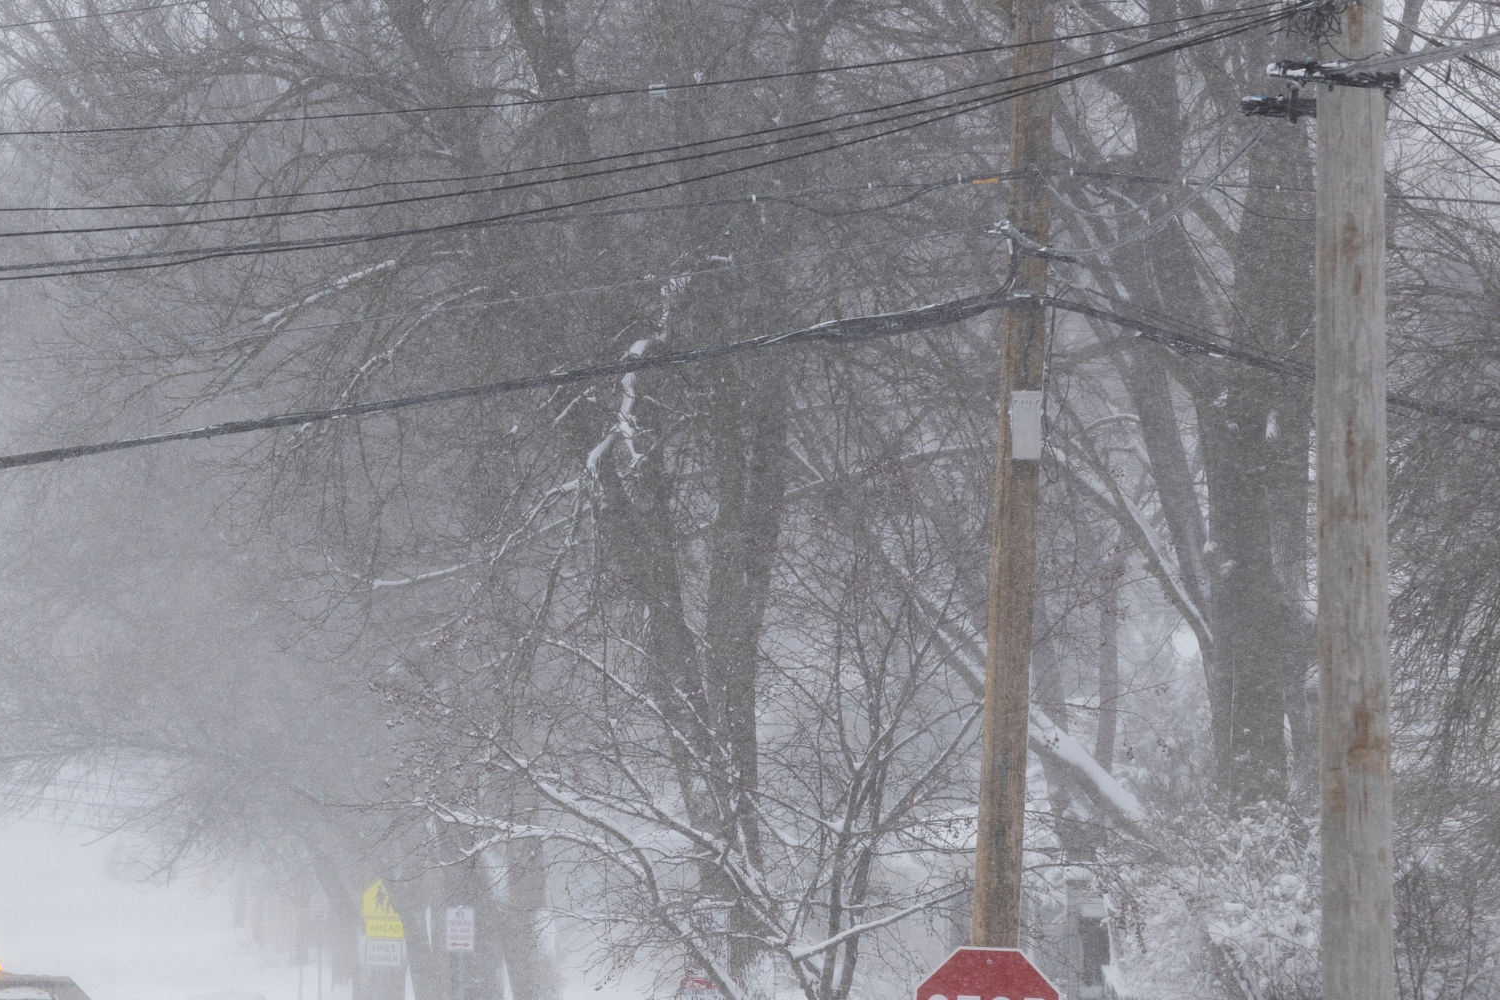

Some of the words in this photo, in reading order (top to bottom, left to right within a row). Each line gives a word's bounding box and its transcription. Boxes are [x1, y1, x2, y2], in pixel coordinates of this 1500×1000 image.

[455, 911, 465, 920] NO
[369, 923, 401, 933] AHEAD
[372, 944, 396, 953] FINES
[368, 954, 399, 963] HIGHER
